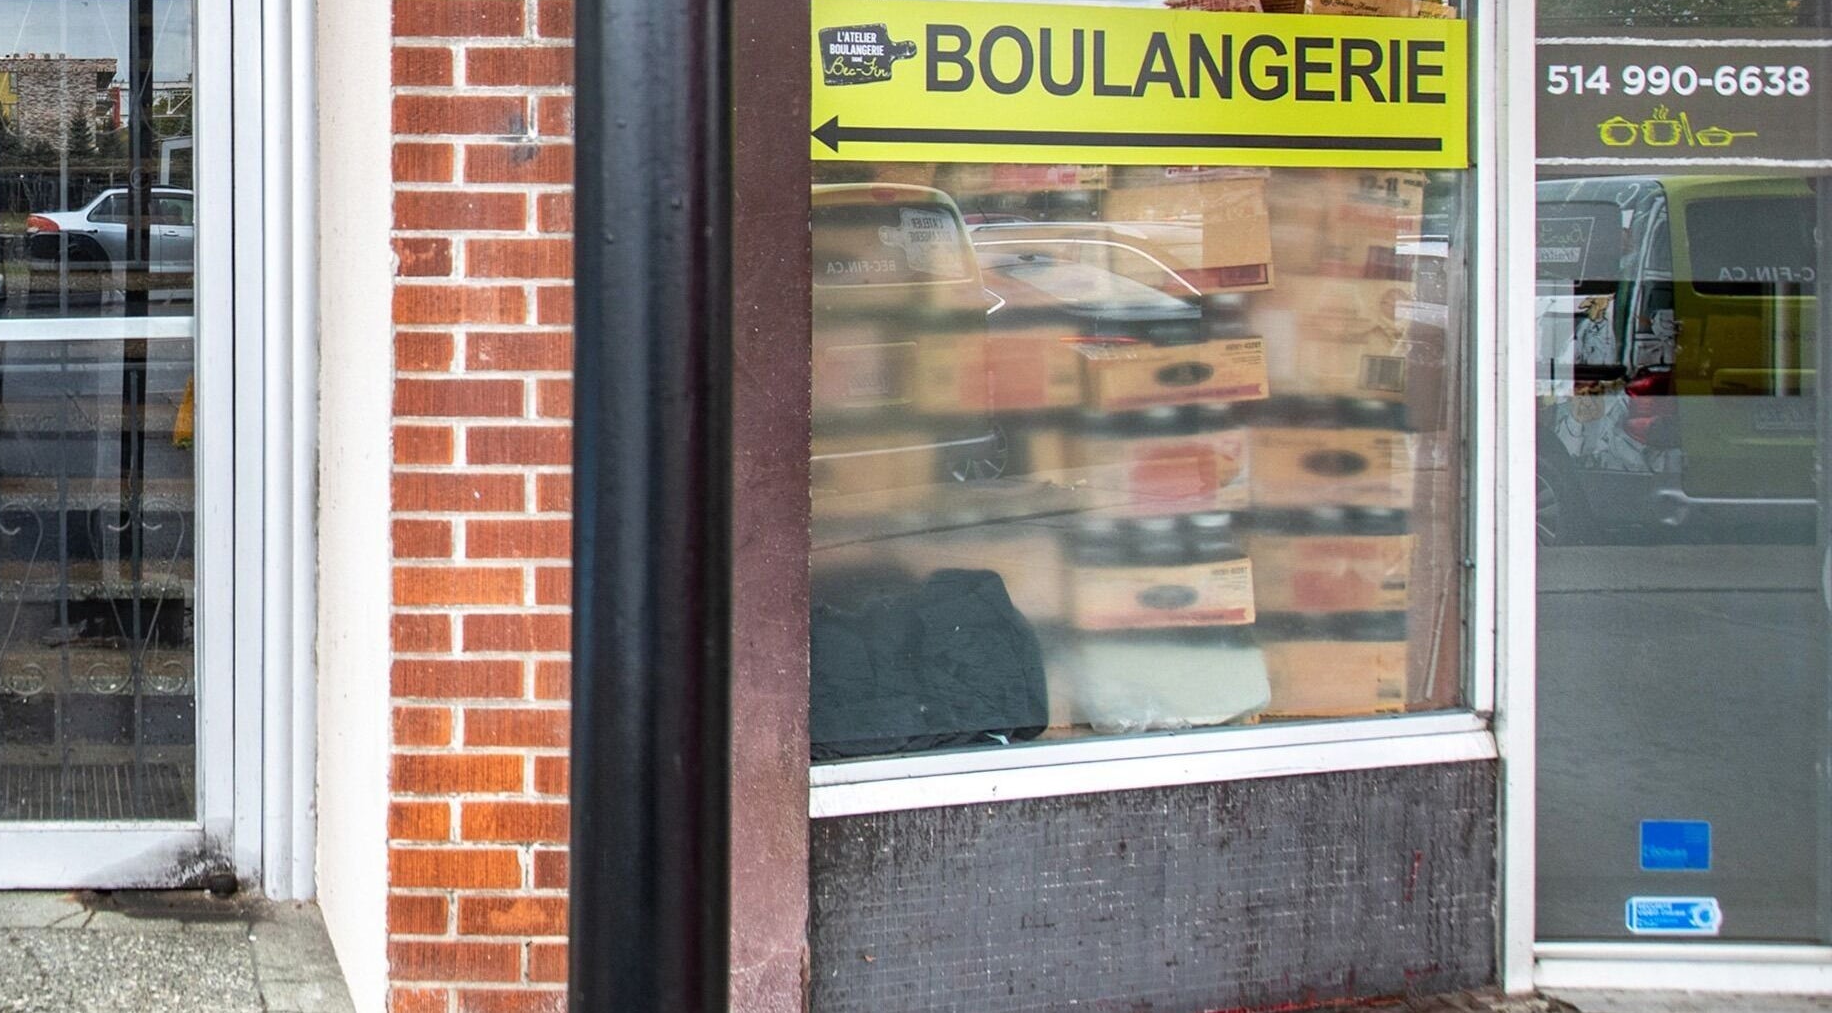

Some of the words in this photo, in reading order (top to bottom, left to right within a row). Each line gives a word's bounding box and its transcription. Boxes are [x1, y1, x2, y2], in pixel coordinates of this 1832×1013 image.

[837, 31, 877, 43] L'ATELIER
[829, 44, 884, 55] BOULANGERIE
[925, 23, 1447, 104] BOULANGERIE
[1547, 65, 1611, 95] 514
[1622, 65, 1811, 96] 990-6638
